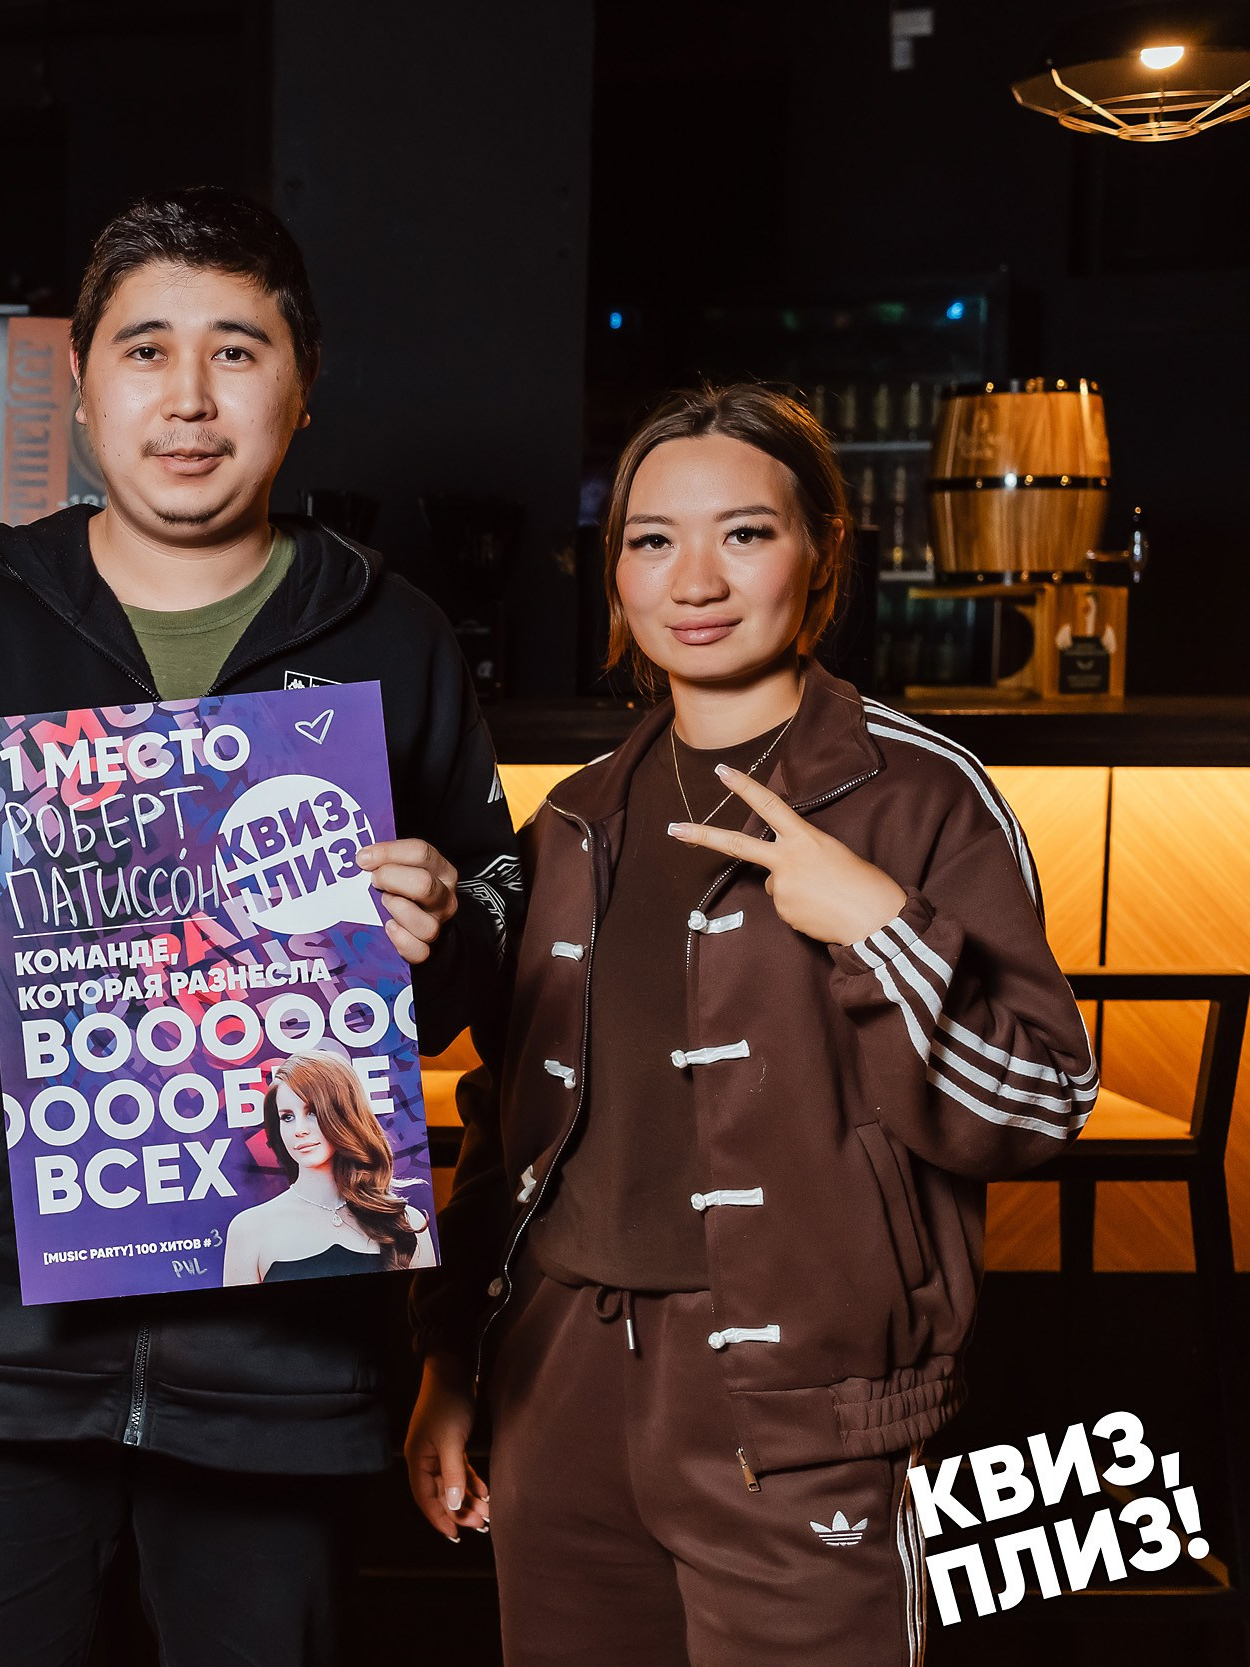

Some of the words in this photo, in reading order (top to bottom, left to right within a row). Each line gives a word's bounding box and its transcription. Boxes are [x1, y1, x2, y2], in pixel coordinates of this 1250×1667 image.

[0, 746, 25, 791] 1
[43, 724, 250, 789] МЕСТО
[4, 786, 204, 860] РОБЕРТ
[15, 938, 179, 976] КОМАНДЕ,
[18, 974, 164, 1010] КОТОРАЯ
[170, 958, 332, 996] РАЗНЕСЛА
[34, 1138, 238, 1216] ВСЕХ
[43, 1249, 88, 1265] [MUSIC
[90, 1243, 134, 1260] PARTY]
[135, 1242, 158, 1255] 100
[159, 1238, 202, 1253] ХИТОВ
